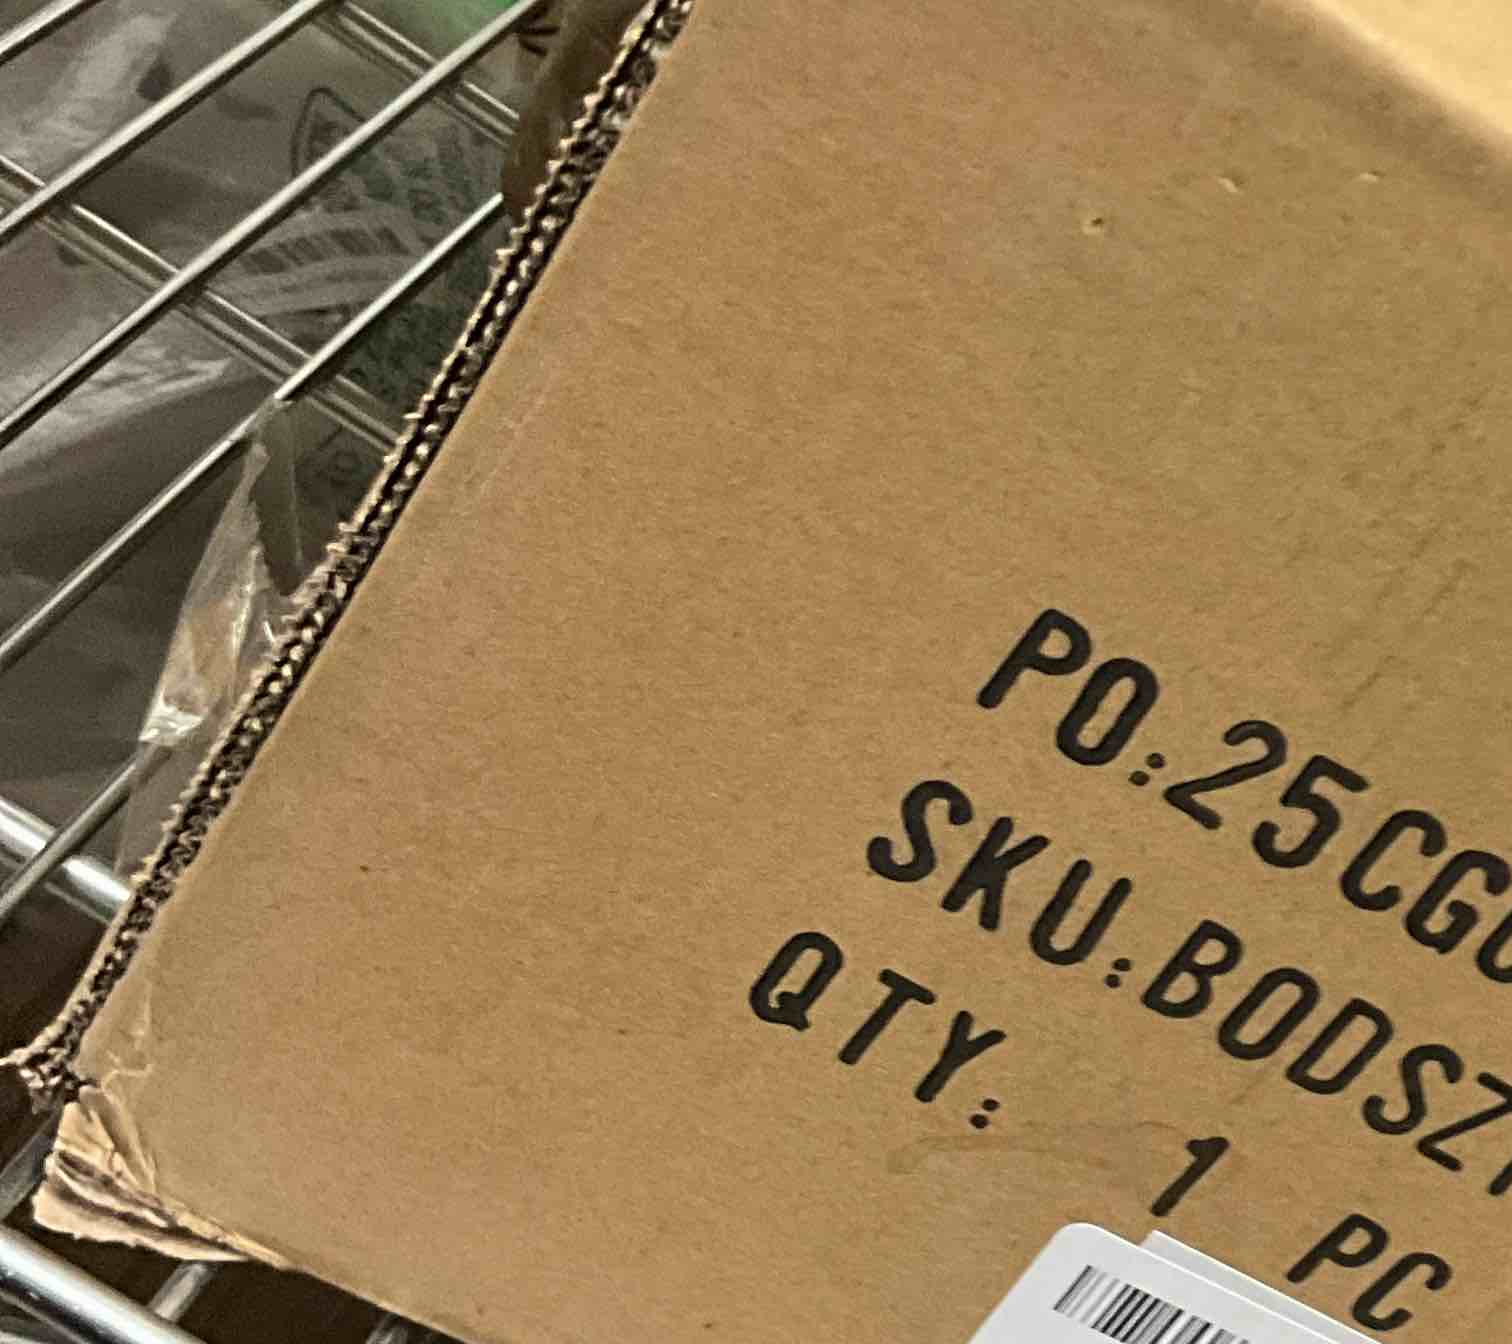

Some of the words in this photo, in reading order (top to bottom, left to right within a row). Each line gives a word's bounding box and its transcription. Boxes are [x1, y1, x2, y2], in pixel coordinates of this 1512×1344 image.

[747, 930, 1001, 1130] QTY:
[1149, 1135, 1231, 1219] 1
[1284, 1212, 1453, 1333] PC
